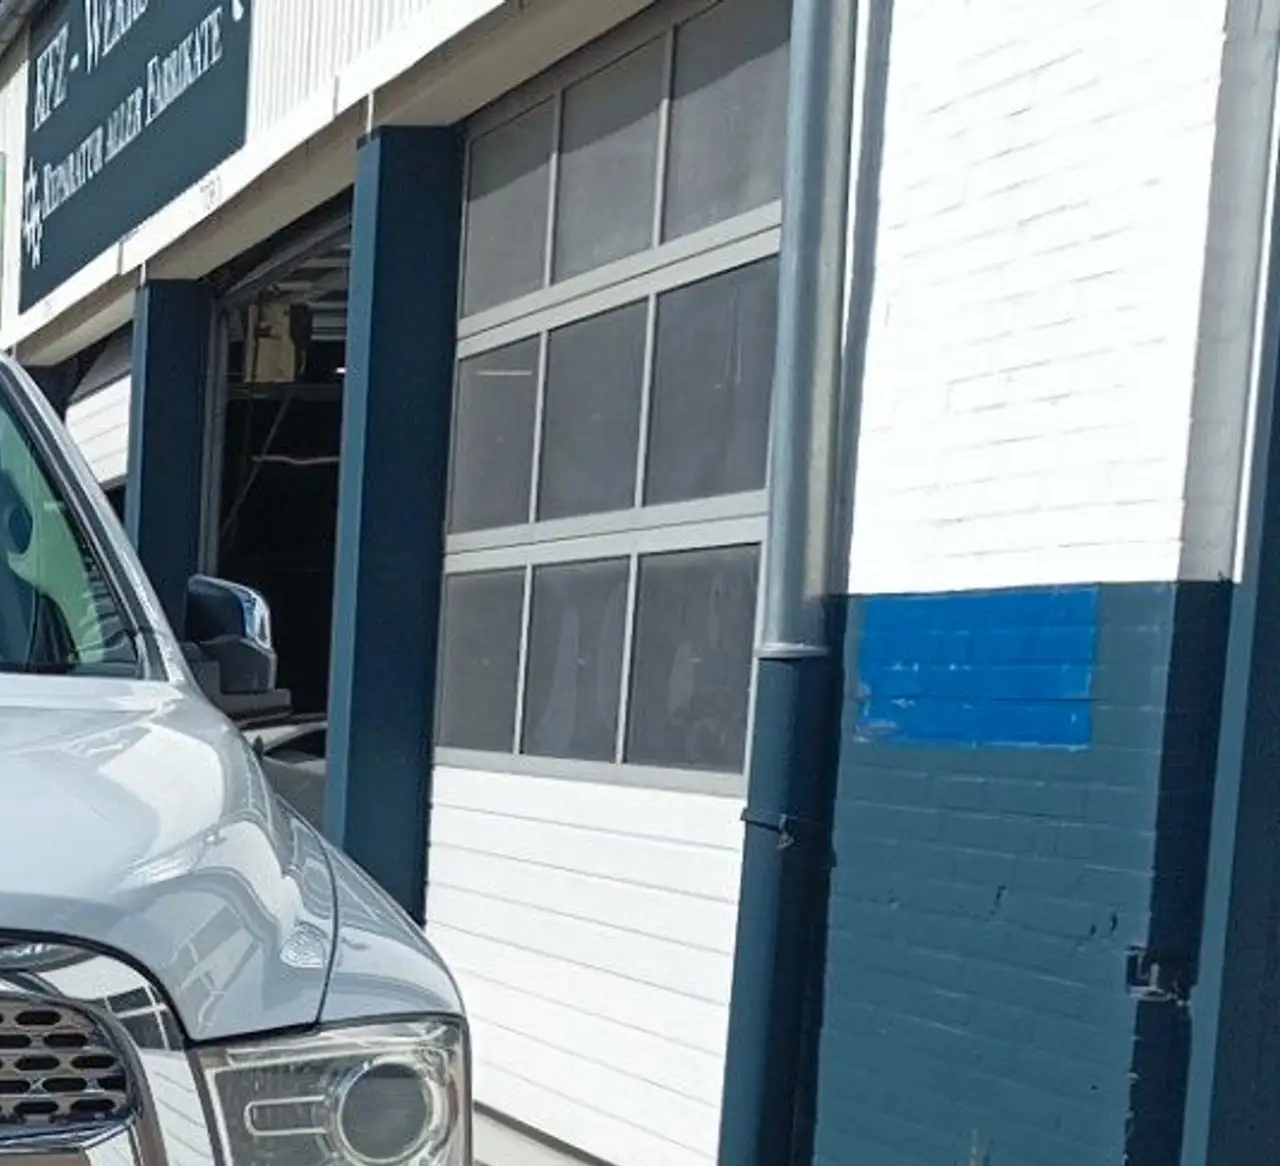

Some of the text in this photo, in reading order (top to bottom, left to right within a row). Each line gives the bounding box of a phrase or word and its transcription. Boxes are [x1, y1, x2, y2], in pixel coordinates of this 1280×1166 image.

[33, 22, 71, 132] KFZ
[105, 86, 143, 165] ALLER
[145, 6, 223, 127] FABRIKATE
